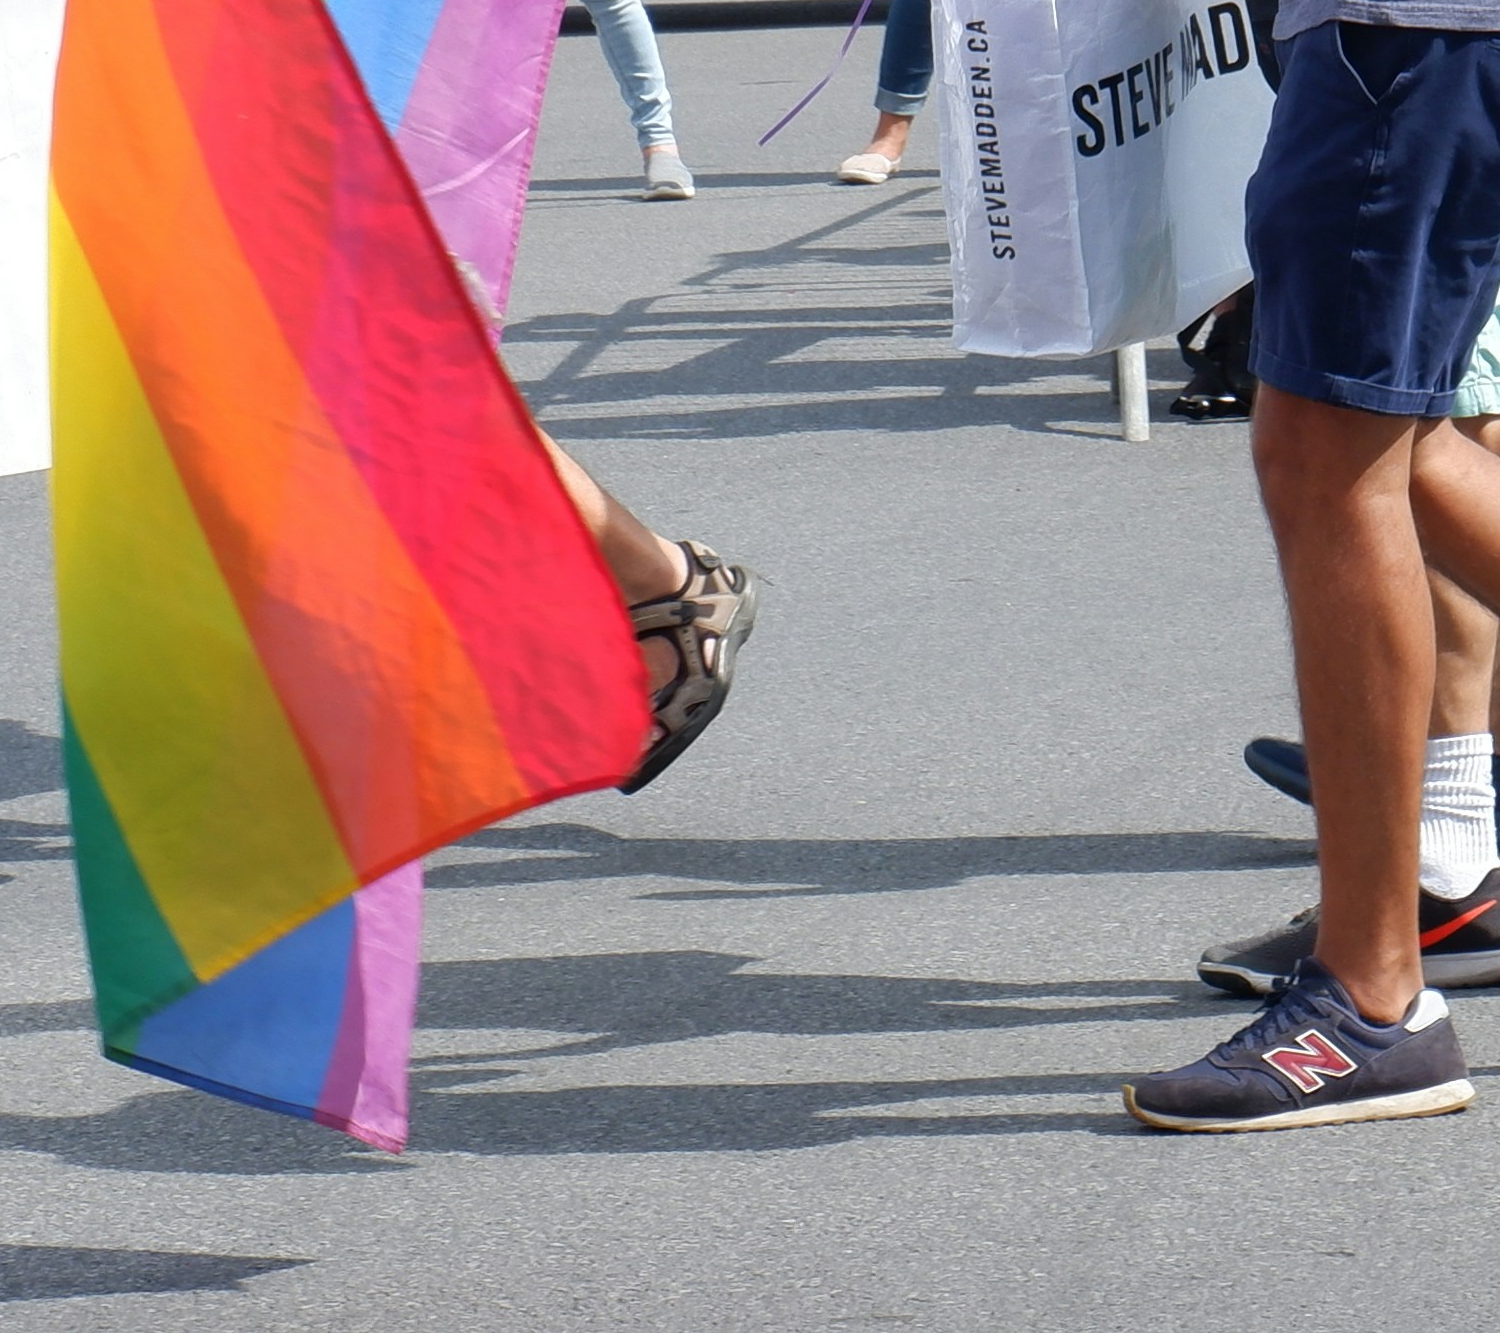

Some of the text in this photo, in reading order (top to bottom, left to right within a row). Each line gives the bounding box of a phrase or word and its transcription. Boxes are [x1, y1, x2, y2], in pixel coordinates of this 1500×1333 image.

[965, 19, 1016, 261] STEVEMADDEN.CA
[1071, 42, 1175, 158] STEVE
[1261, 1028, 1359, 1094] N
